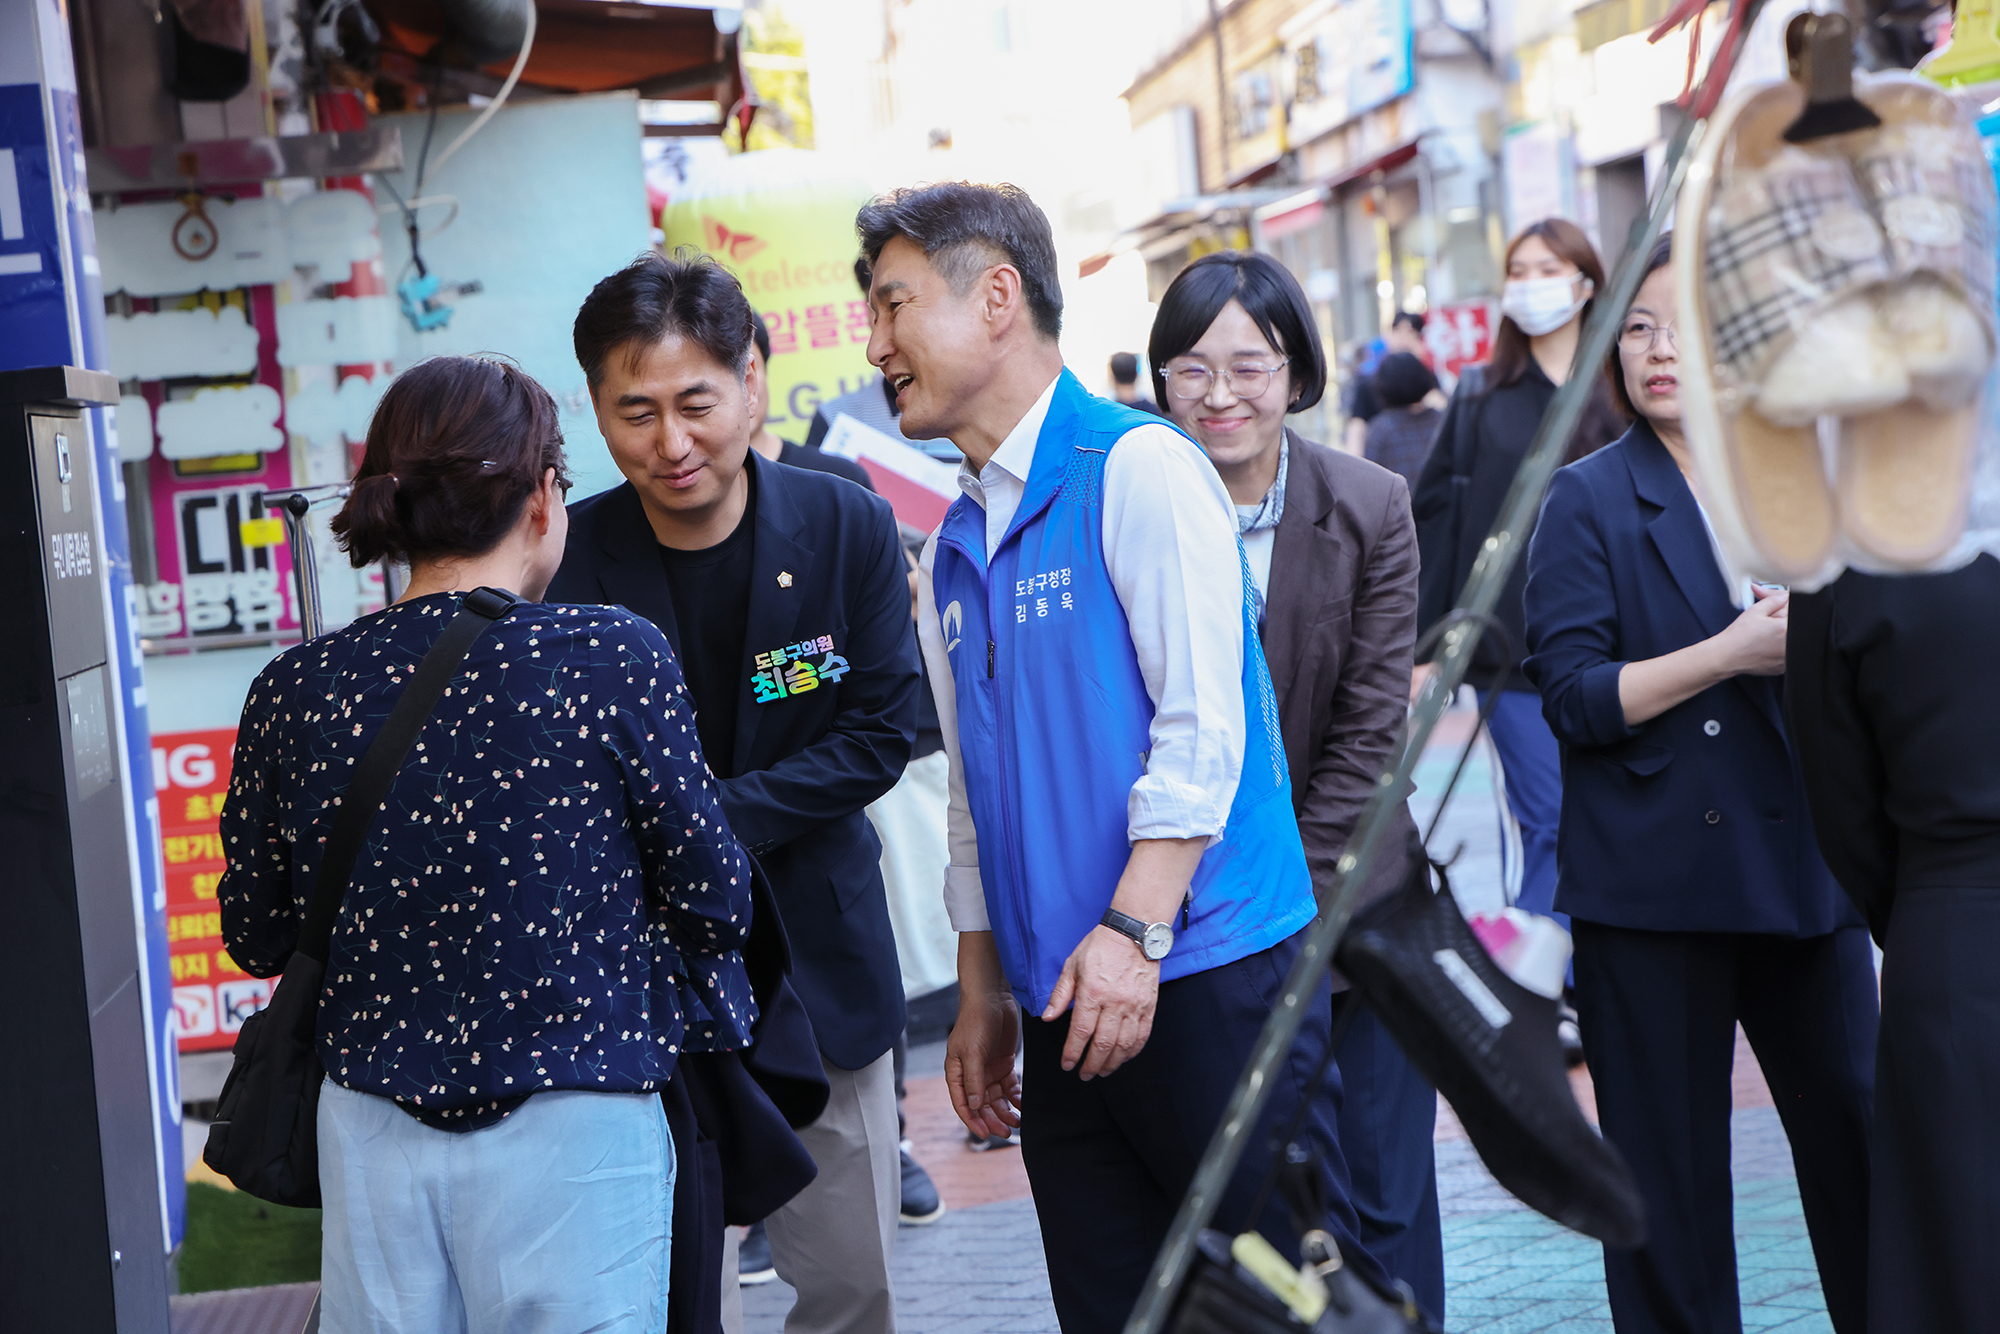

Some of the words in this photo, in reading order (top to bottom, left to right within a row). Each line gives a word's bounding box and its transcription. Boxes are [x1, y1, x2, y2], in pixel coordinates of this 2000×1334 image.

[762, 299, 870, 354] 알뜰폰
[1015, 567, 1072, 597] 도봉구청장
[754, 634, 835, 670] 도봉구의원
[751, 651, 851, 704] 최승수
